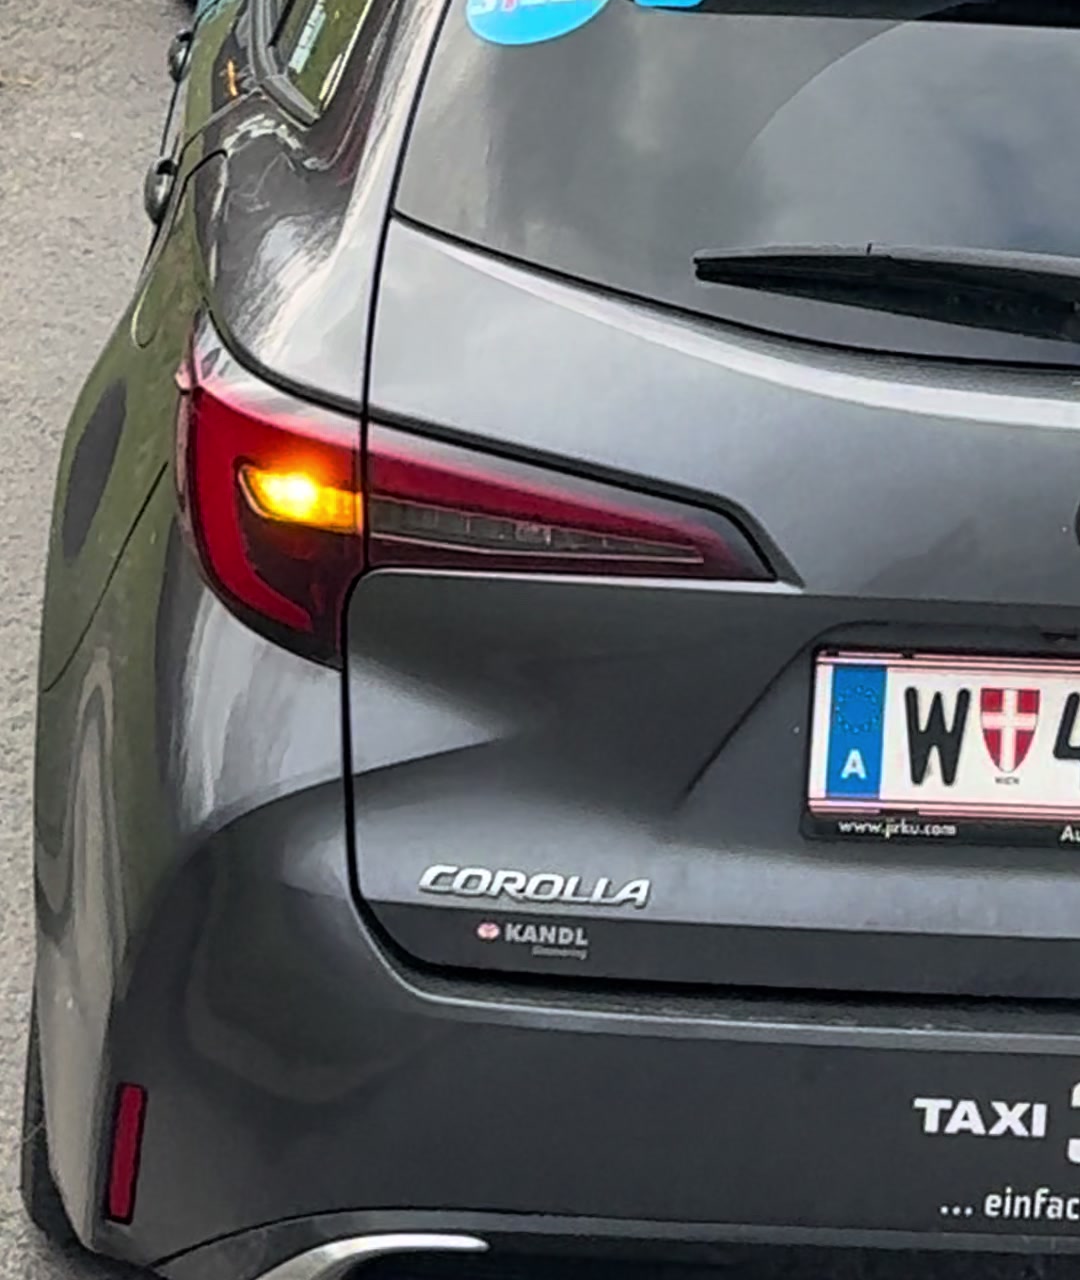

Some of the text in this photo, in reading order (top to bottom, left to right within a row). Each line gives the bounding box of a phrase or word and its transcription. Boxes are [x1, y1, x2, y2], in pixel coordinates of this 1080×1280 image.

[904, 686, 971, 785] W
[840, 749, 867, 780] A
[838, 817, 957, 839] www.jirku.com
[420, 864, 651, 909] COROLLA
[504, 922, 588, 946] KANDL
[913, 1097, 1047, 1138] TAXI
